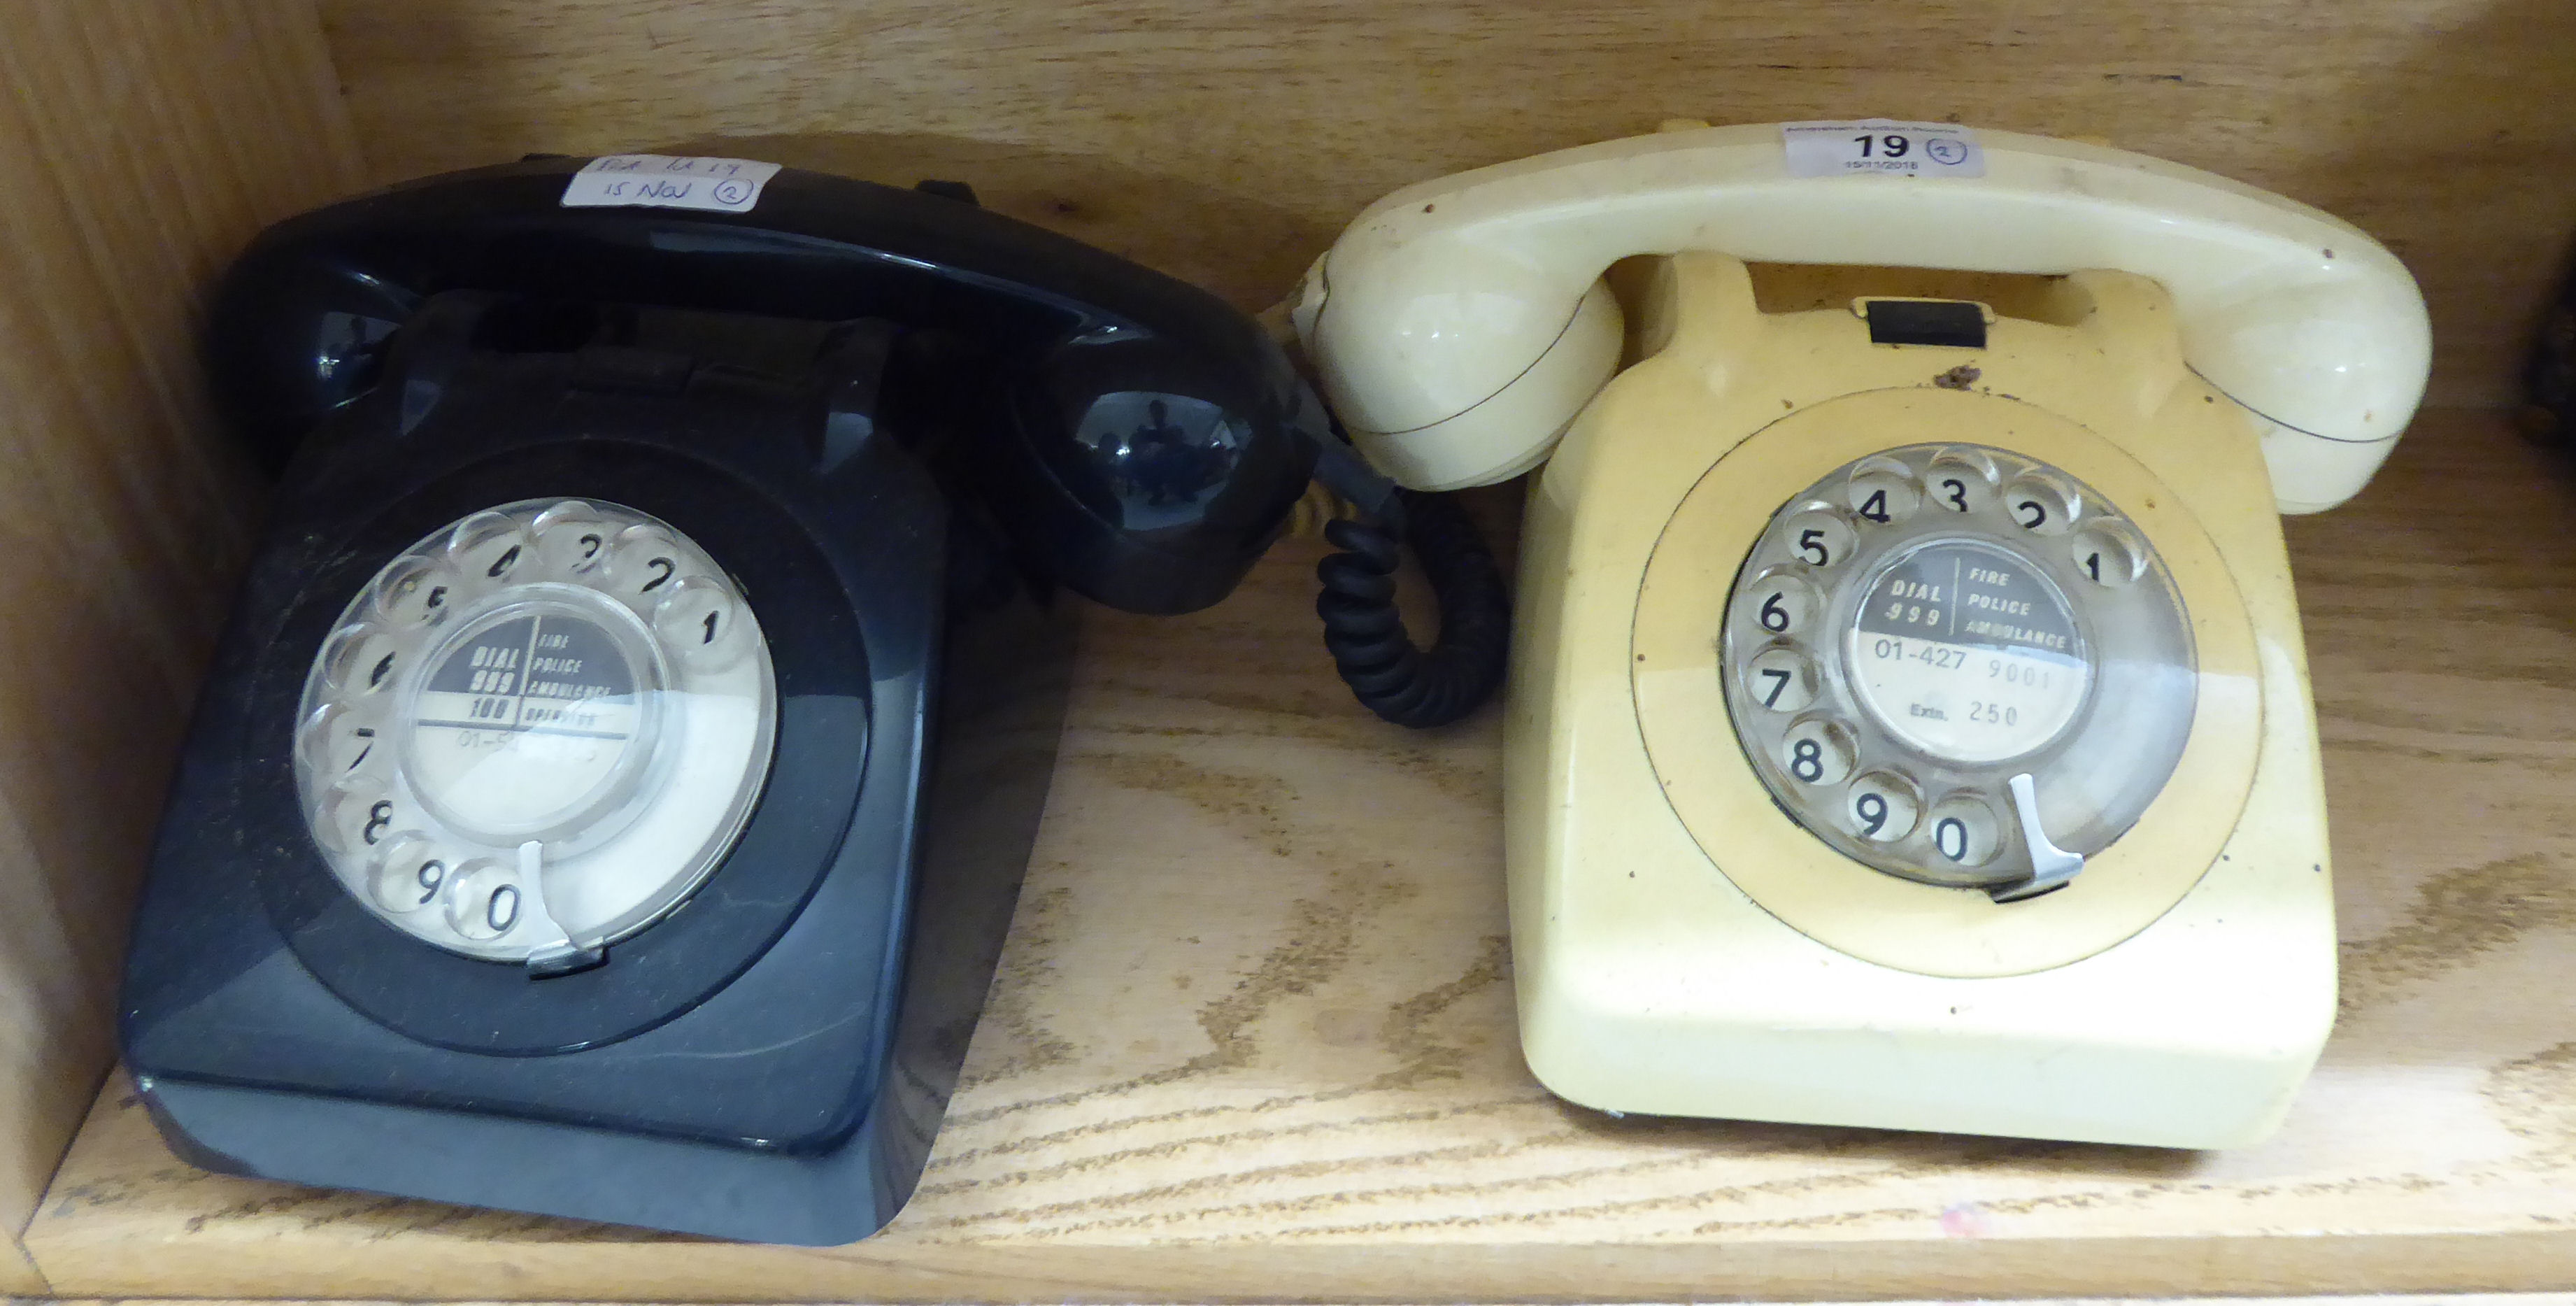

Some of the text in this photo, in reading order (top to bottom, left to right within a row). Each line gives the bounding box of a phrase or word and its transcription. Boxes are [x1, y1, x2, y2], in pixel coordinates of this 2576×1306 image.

[1854, 134, 1910, 157] 19
[1935, 145, 1951, 157] 2
[604, 181, 630, 197] 15
[723, 187, 738, 200] 2
[1859, 489, 1891, 524] 4
[1942, 478, 1967, 513] 3
[1799, 529, 1828, 568] 5
[1967, 567, 2011, 586] FIRE
[2085, 551, 2100, 582] 1
[1891, 579, 1942, 603] DIAL
[1966, 593, 2031, 616] POLICE
[702, 610, 720, 644] 1
[1760, 591, 1791, 632] 6
[1887, 602, 1940, 627] 999
[1964, 620, 2066, 649] AMBULANCE
[469, 646, 520, 669] DIAL
[532, 657, 583, 674] POLICE
[1874, 638, 2050, 690] 01-427 9001
[468, 669, 515, 695] 999
[1760, 668, 1792, 711] 7
[469, 698, 509, 719] 100
[1969, 701, 2018, 727] 250
[1790, 738, 1824, 783] 8
[364, 799, 393, 846] 8
[1856, 793, 1888, 837] 9
[1935, 817, 1969, 863] 0
[418, 860, 446, 904] 9
[488, 883, 521, 931] 0
